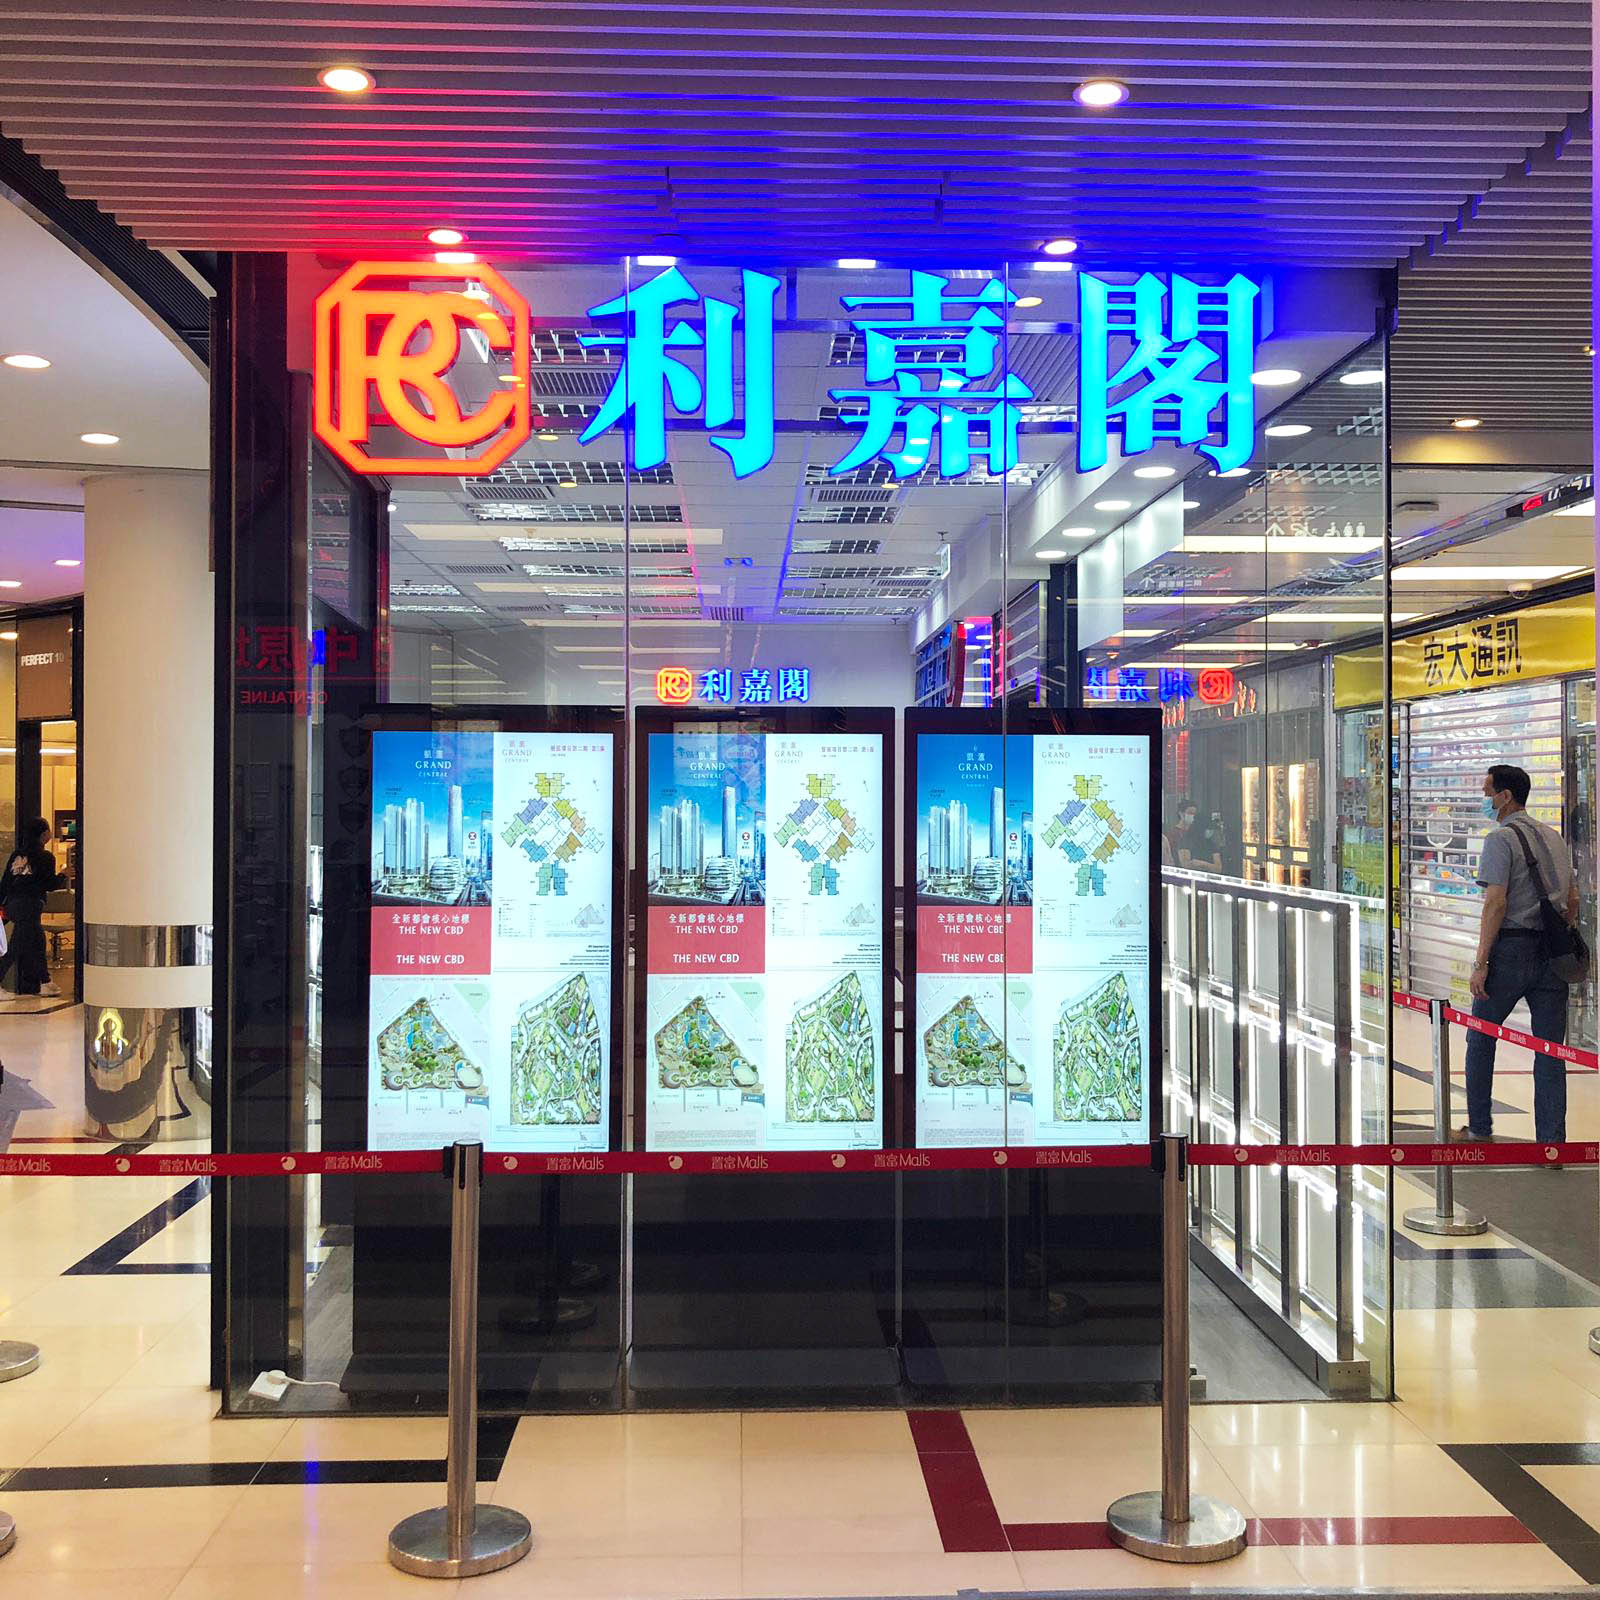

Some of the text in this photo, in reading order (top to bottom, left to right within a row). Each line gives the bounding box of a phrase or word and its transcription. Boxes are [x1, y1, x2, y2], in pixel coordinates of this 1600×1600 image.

[577, 265, 1261, 479] 利嘉閣
[1424, 618, 1522, 687] 宏大通訊
[21, 652, 54, 666] PERFECT
[700, 668, 809, 702] 利嘉閣
[415, 761, 452, 769] GRAND
[690, 762, 725, 771] GRAND
[958, 763, 993, 771] GRAND
[399, 926, 464, 935] THE NEW CBD
[675, 925, 739, 934] THE NEW CBD
[944, 925, 960, 934] THE
[964, 925, 984, 934] NEW
[396, 954, 465, 964] THE NEW CBD
[673, 953, 740, 963] THE NEW CBD
[942, 953, 960, 963] THE
[962, 953, 985, 963] NEW
